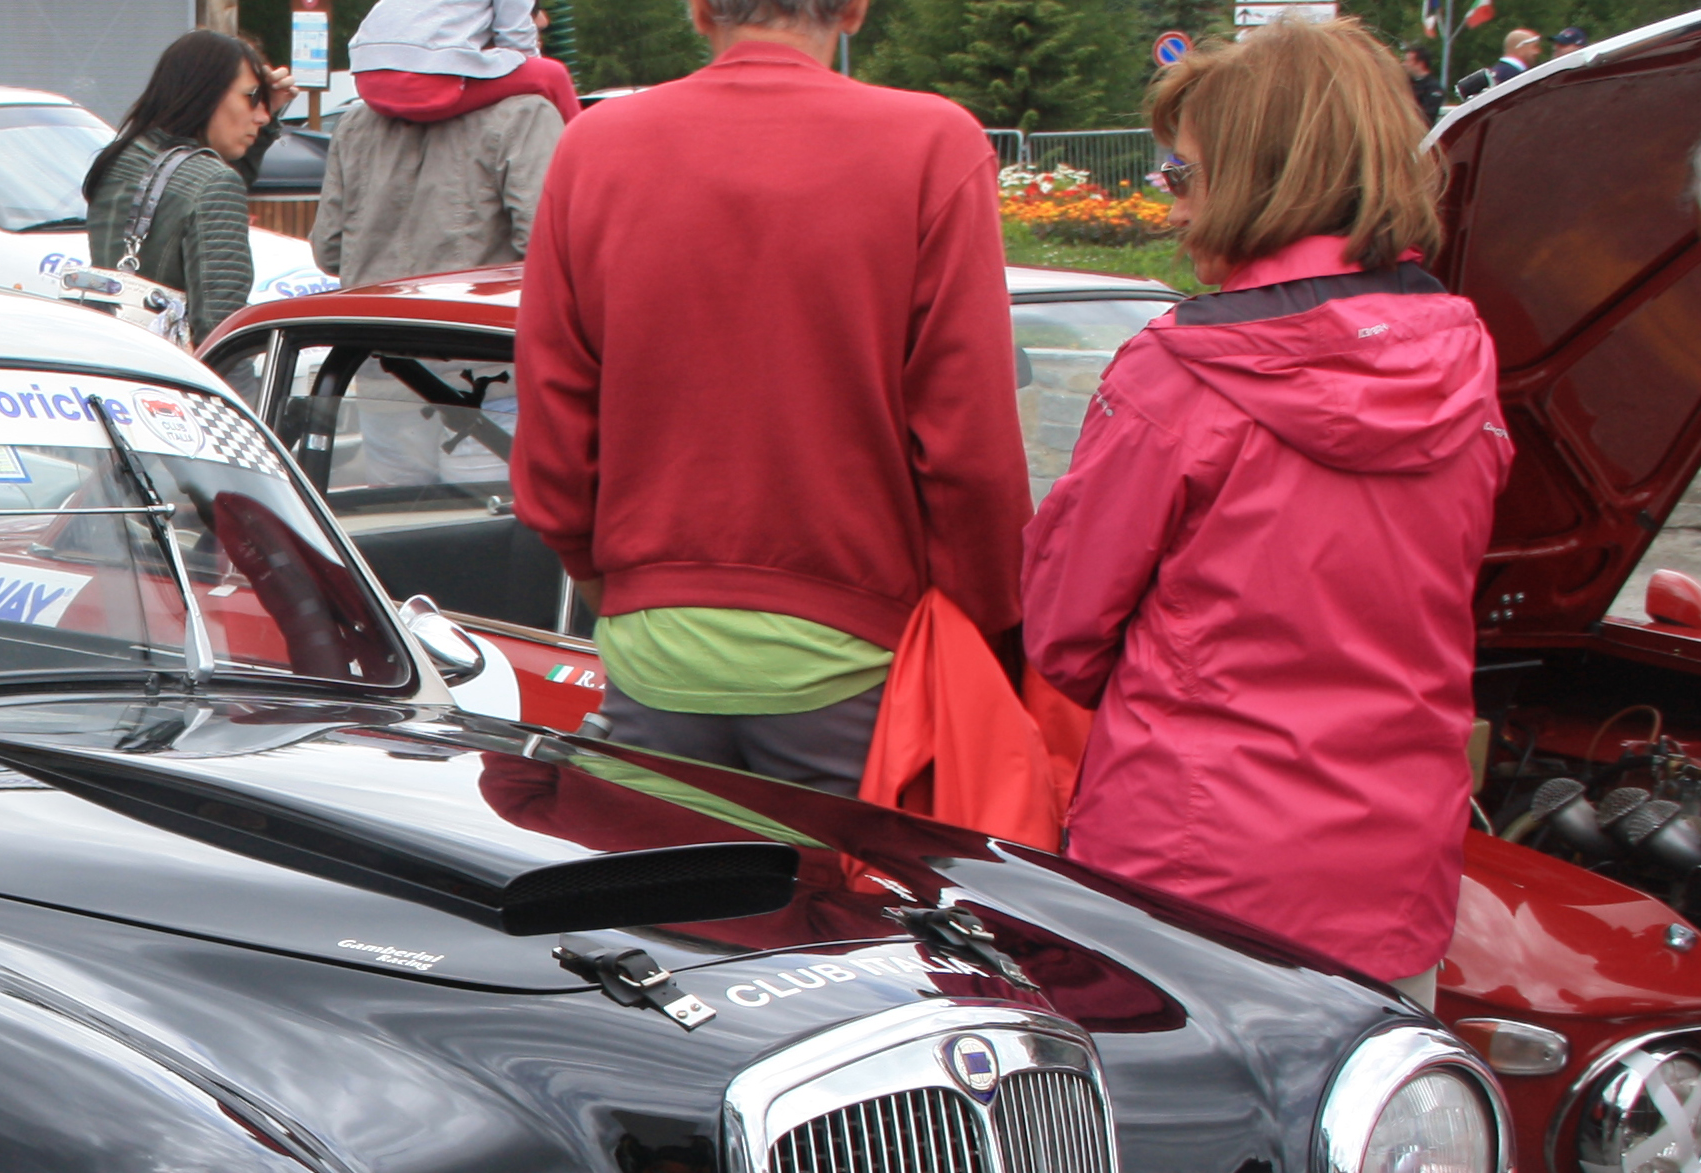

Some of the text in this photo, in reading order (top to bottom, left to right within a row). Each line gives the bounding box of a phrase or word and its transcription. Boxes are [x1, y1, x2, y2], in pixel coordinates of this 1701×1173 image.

[161, 421, 188, 432] CLUB
[166, 431, 194, 443] ITALIA
[337, 939, 445, 963] Gamberini
[375, 954, 433, 971] Racing
[725, 955, 991, 1008] CLUB ITALIA
